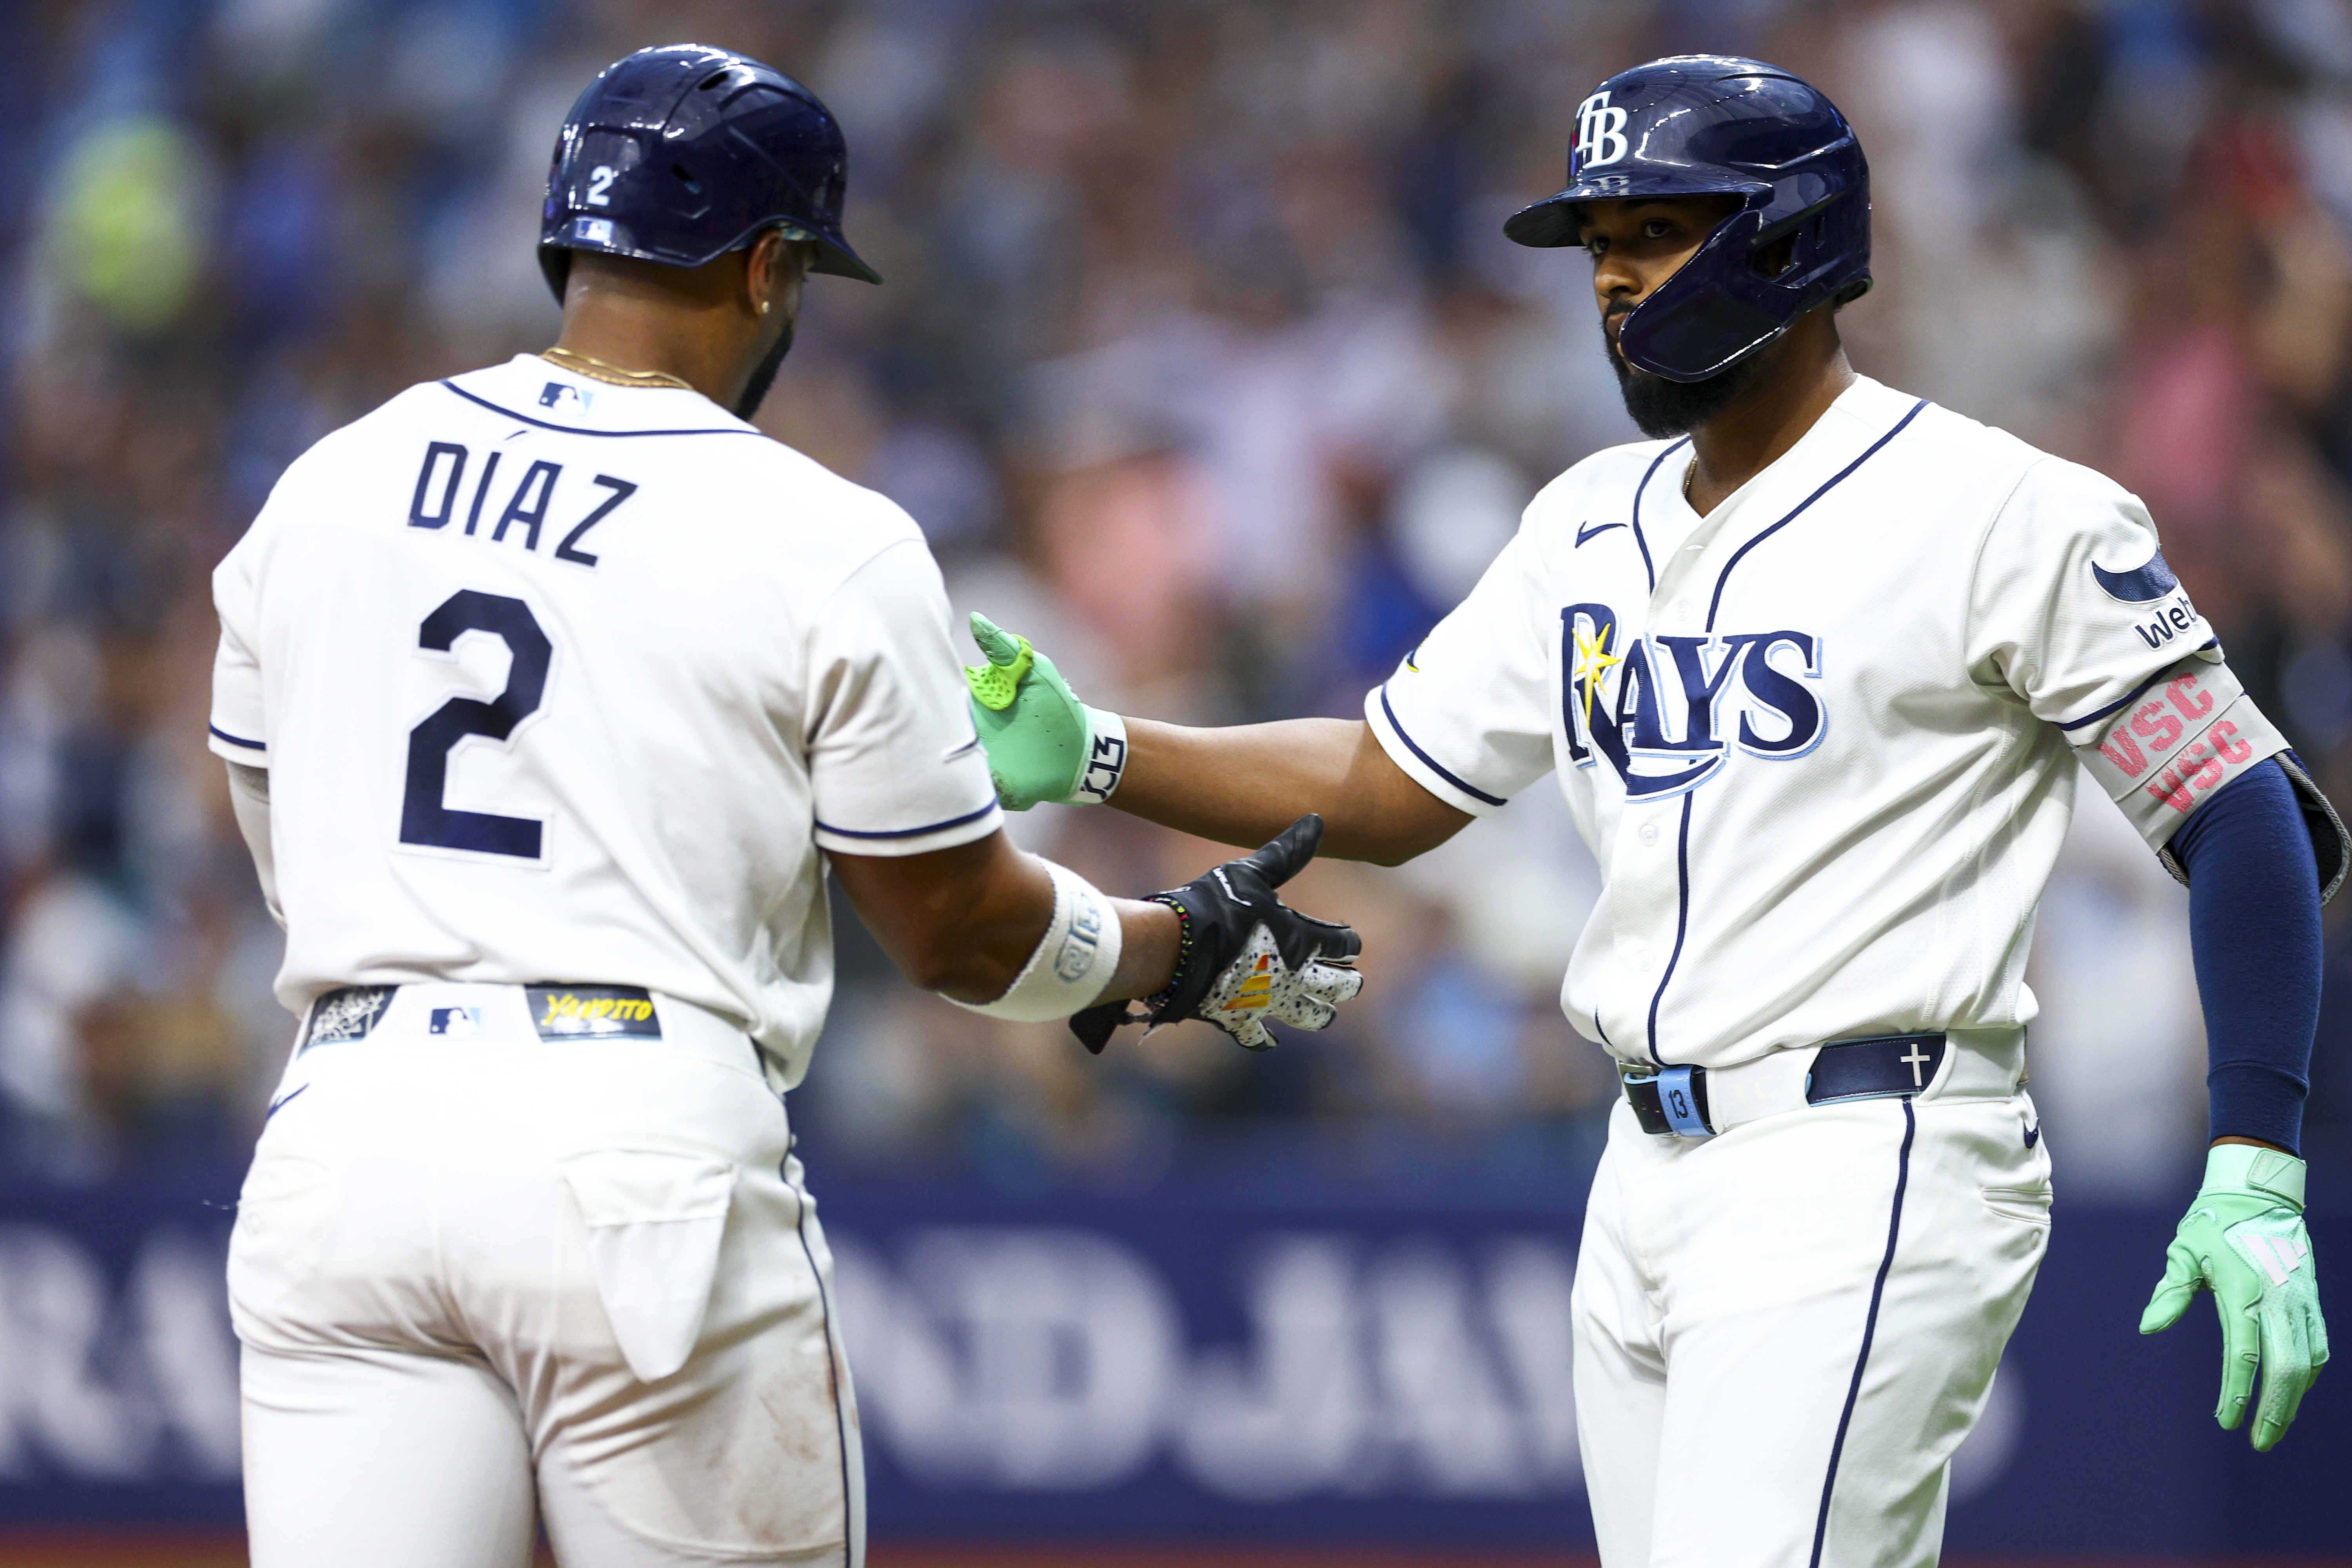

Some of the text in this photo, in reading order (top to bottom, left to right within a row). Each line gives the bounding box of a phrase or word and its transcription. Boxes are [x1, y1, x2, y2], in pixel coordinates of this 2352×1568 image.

[1575, 91, 1628, 169] TB
[587, 165, 614, 207] 2
[407, 430, 638, 567] DÍAZ
[399, 588, 554, 860] 2
[1560, 603, 1828, 804] RAYS
[2095, 672, 2214, 778] VSC
[2145, 720, 2252, 813] VSC
[541, 993, 653, 1027] YANDITO
[1669, 1089, 1688, 1119] 13
